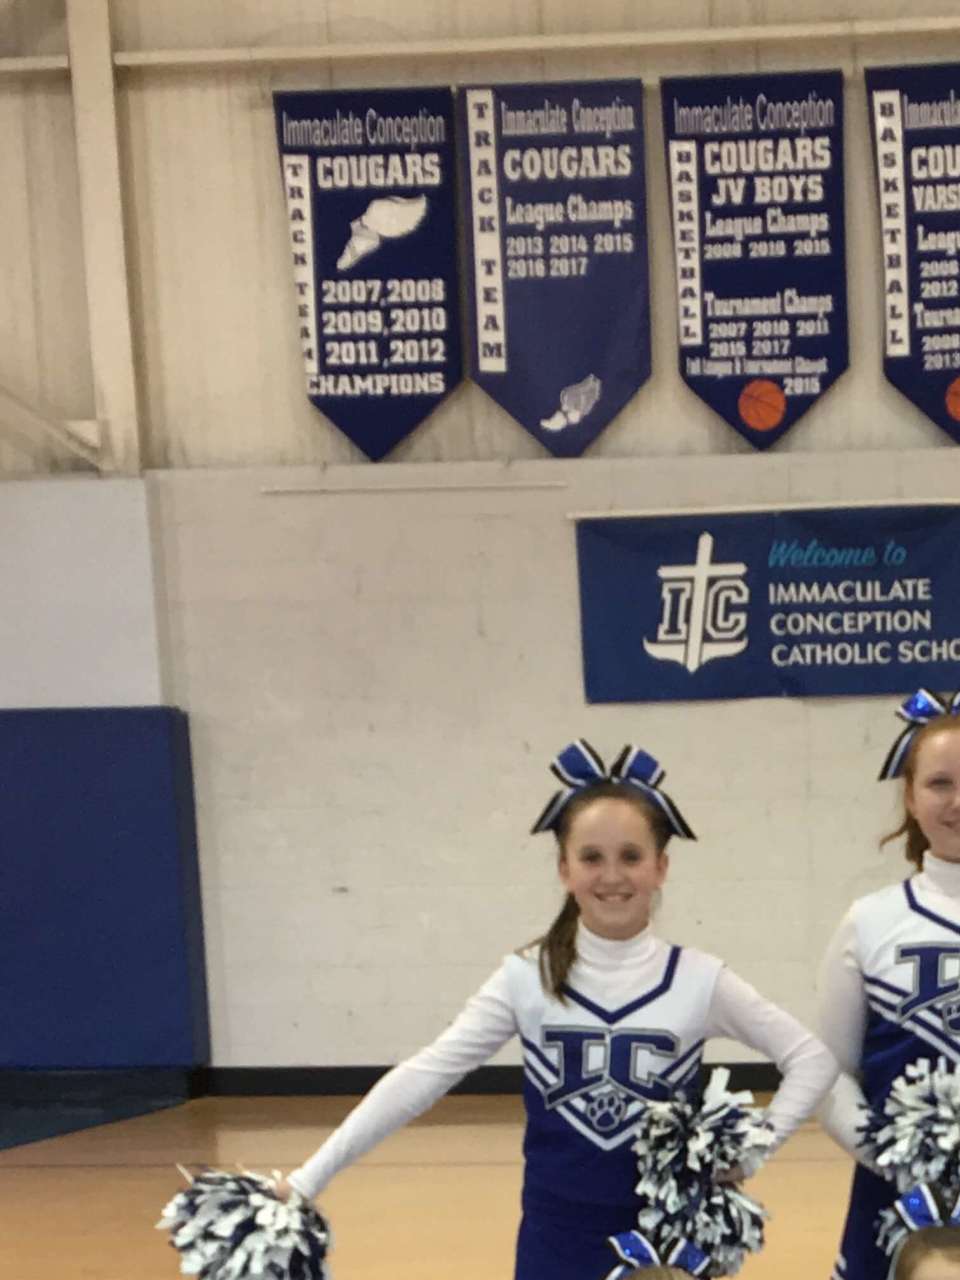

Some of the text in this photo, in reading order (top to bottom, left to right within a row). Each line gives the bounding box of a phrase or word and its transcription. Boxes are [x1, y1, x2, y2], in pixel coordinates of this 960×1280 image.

[282, 107, 446, 151] Immaculate Conception
[501, 96, 635, 139] Immaculate Conception
[673, 90, 834, 135] Immaculate Conception
[316, 152, 441, 188] COUGARS
[503, 145, 632, 181] COUGARS
[704, 136, 831, 174] COUGARS
[711, 174, 824, 206] JV BOYS
[287, 163, 307, 265] TRACK
[505, 193, 634, 231] League Champs
[766, 206, 829, 237] Champs
[880, 102, 903, 344] BASKETBALL
[473, 103, 503, 360] TRACK TEAM
[550, 234, 589, 254] 2014
[593, 233, 634, 253] 2015
[677, 151, 697, 339] BASKETBALL
[549, 257, 588, 277] 2017
[307, 372, 445, 396] CHAMPIONS
[768, 538, 906, 569] Welcome to
[768, 578, 932, 605] IMMACULATE
[770, 609, 932, 636] CONCEPTION
[771, 641, 892, 667] CATHOLIC
[541, 1024, 680, 1110] IC
